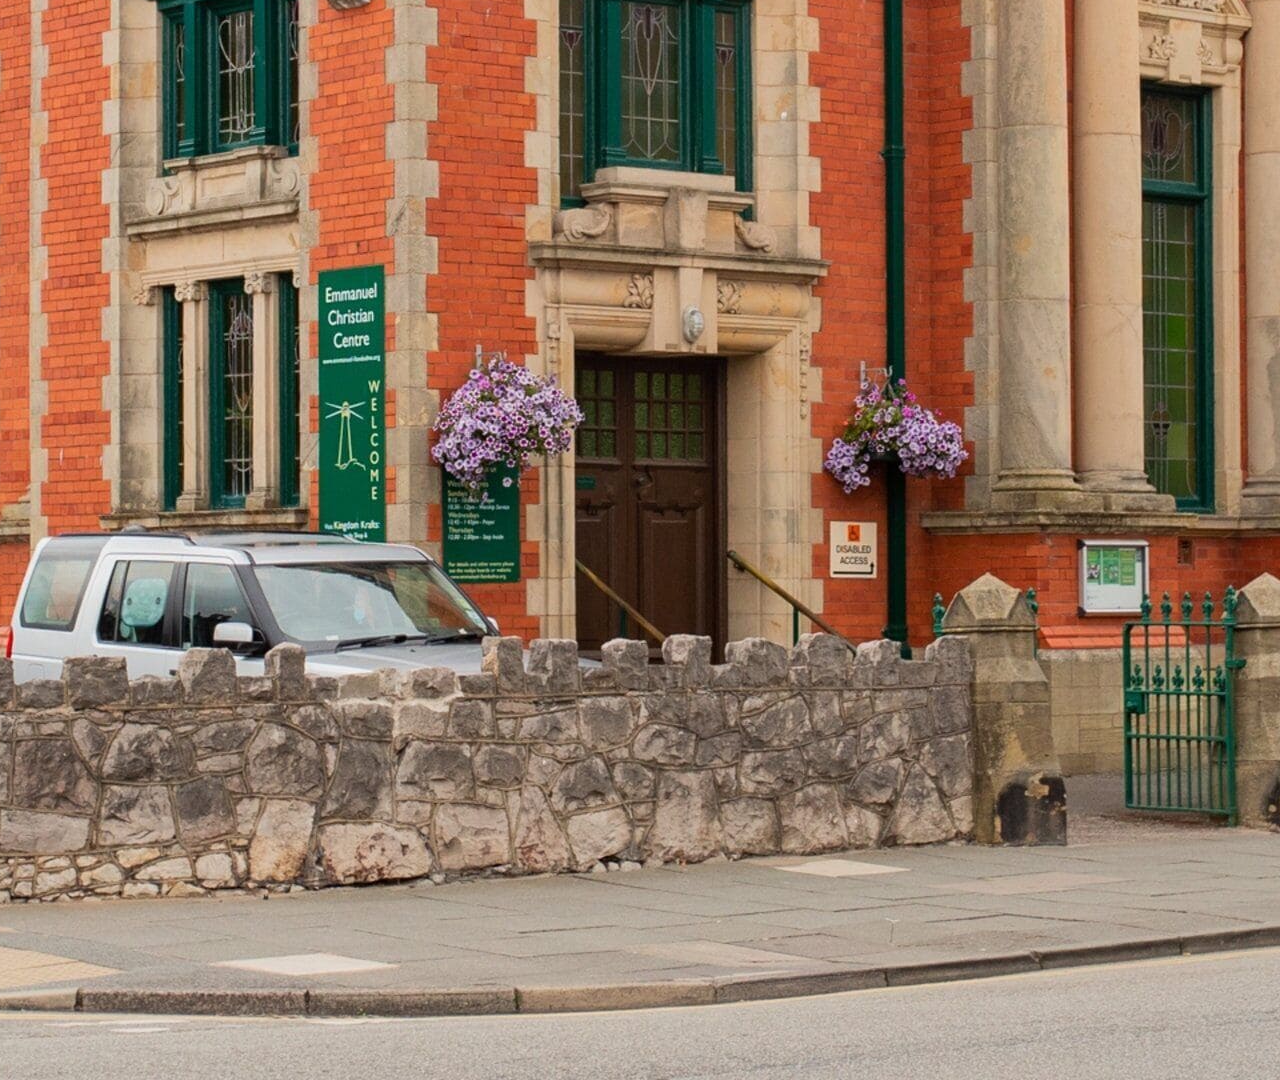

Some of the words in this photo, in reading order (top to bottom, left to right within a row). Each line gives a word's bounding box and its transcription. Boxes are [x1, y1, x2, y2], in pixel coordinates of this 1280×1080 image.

[325, 282, 377, 303] Emmanuel
[328, 308, 374, 326] Christian
[333, 332, 370, 348] Centre
[368, 380, 380, 500] WELCOME
[835, 544, 871, 553] DISABLED
[840, 556, 869, 565] ACCESS
